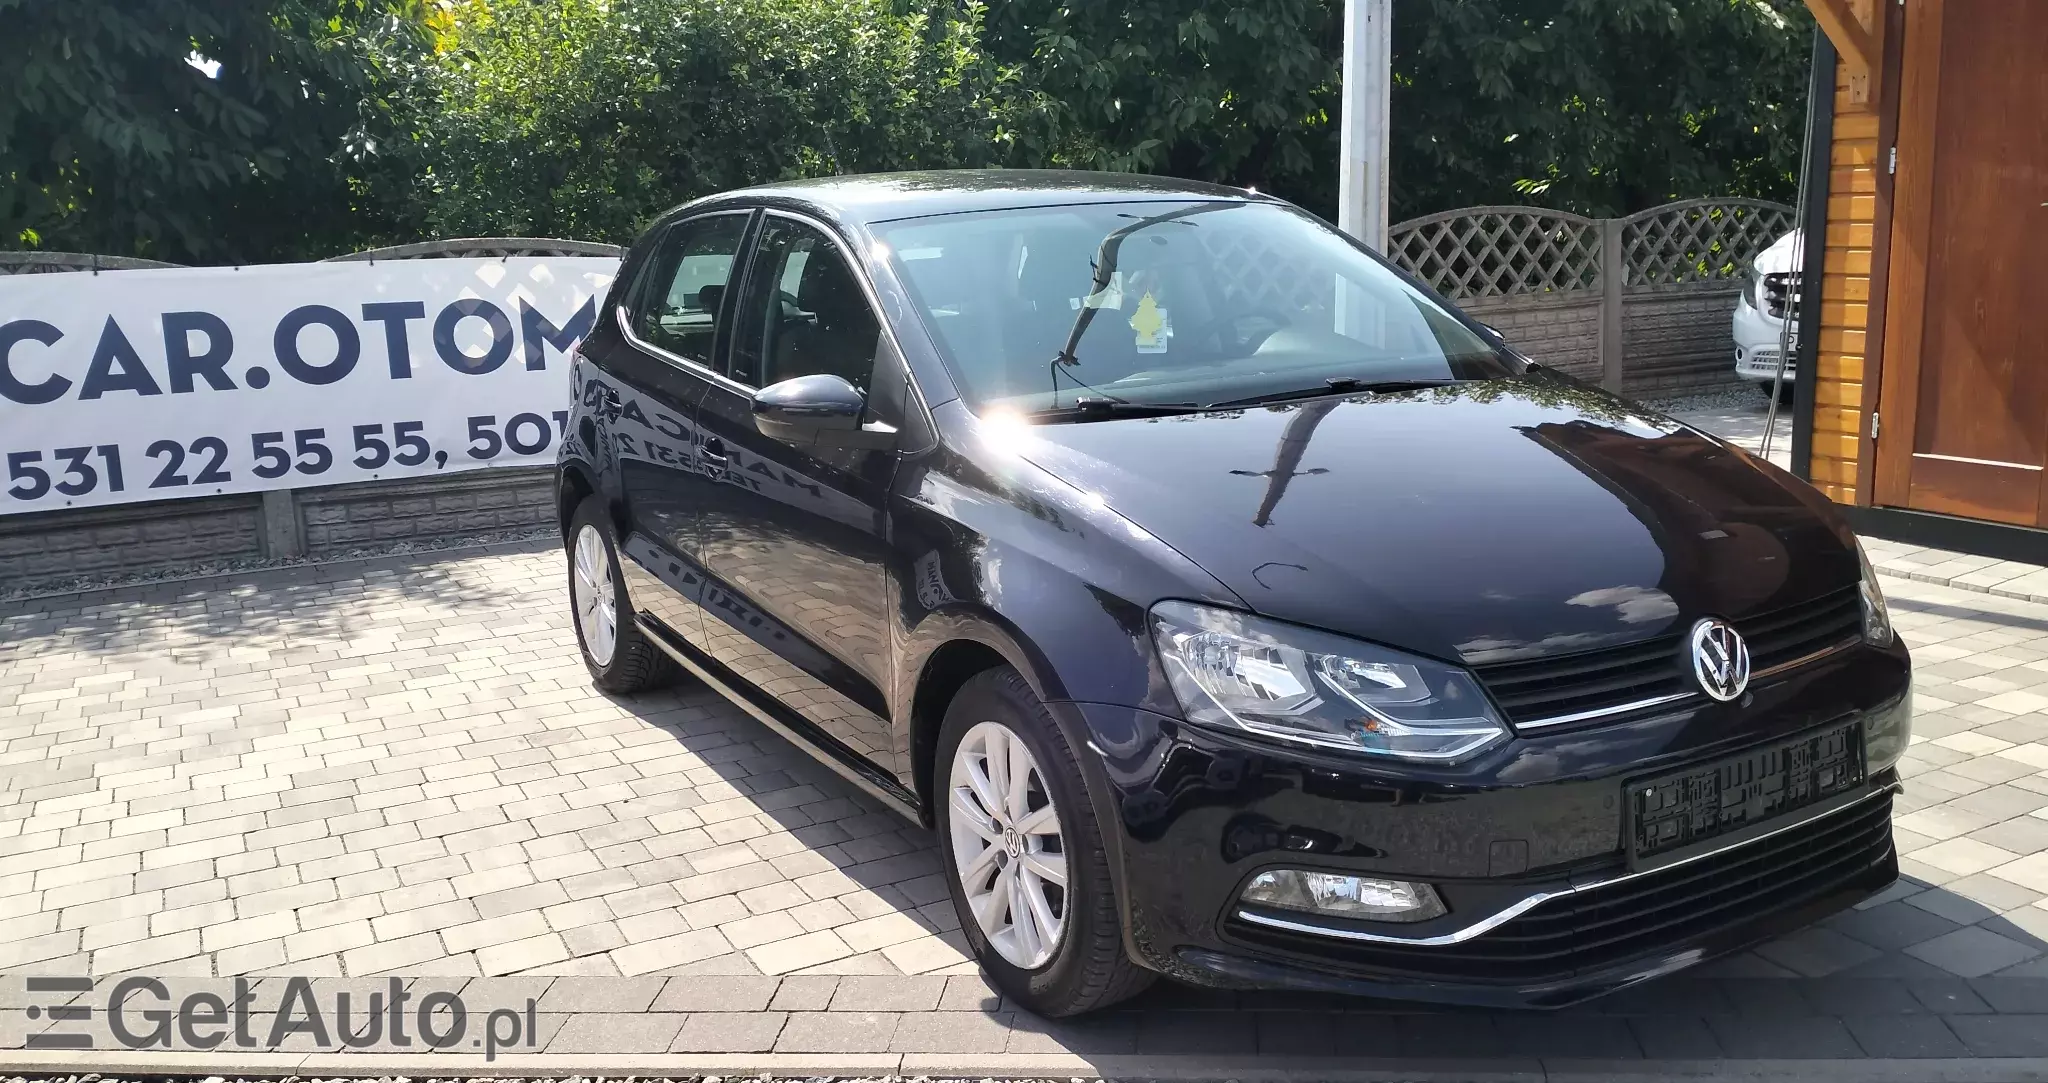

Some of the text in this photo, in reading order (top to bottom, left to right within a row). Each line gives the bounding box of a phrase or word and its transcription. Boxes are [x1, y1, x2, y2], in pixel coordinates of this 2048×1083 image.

[7, 444, 124, 501] 531
[145, 436, 233, 489] 22
[251, 428, 334, 478] 55
[352, 420, 448, 469] 55,
